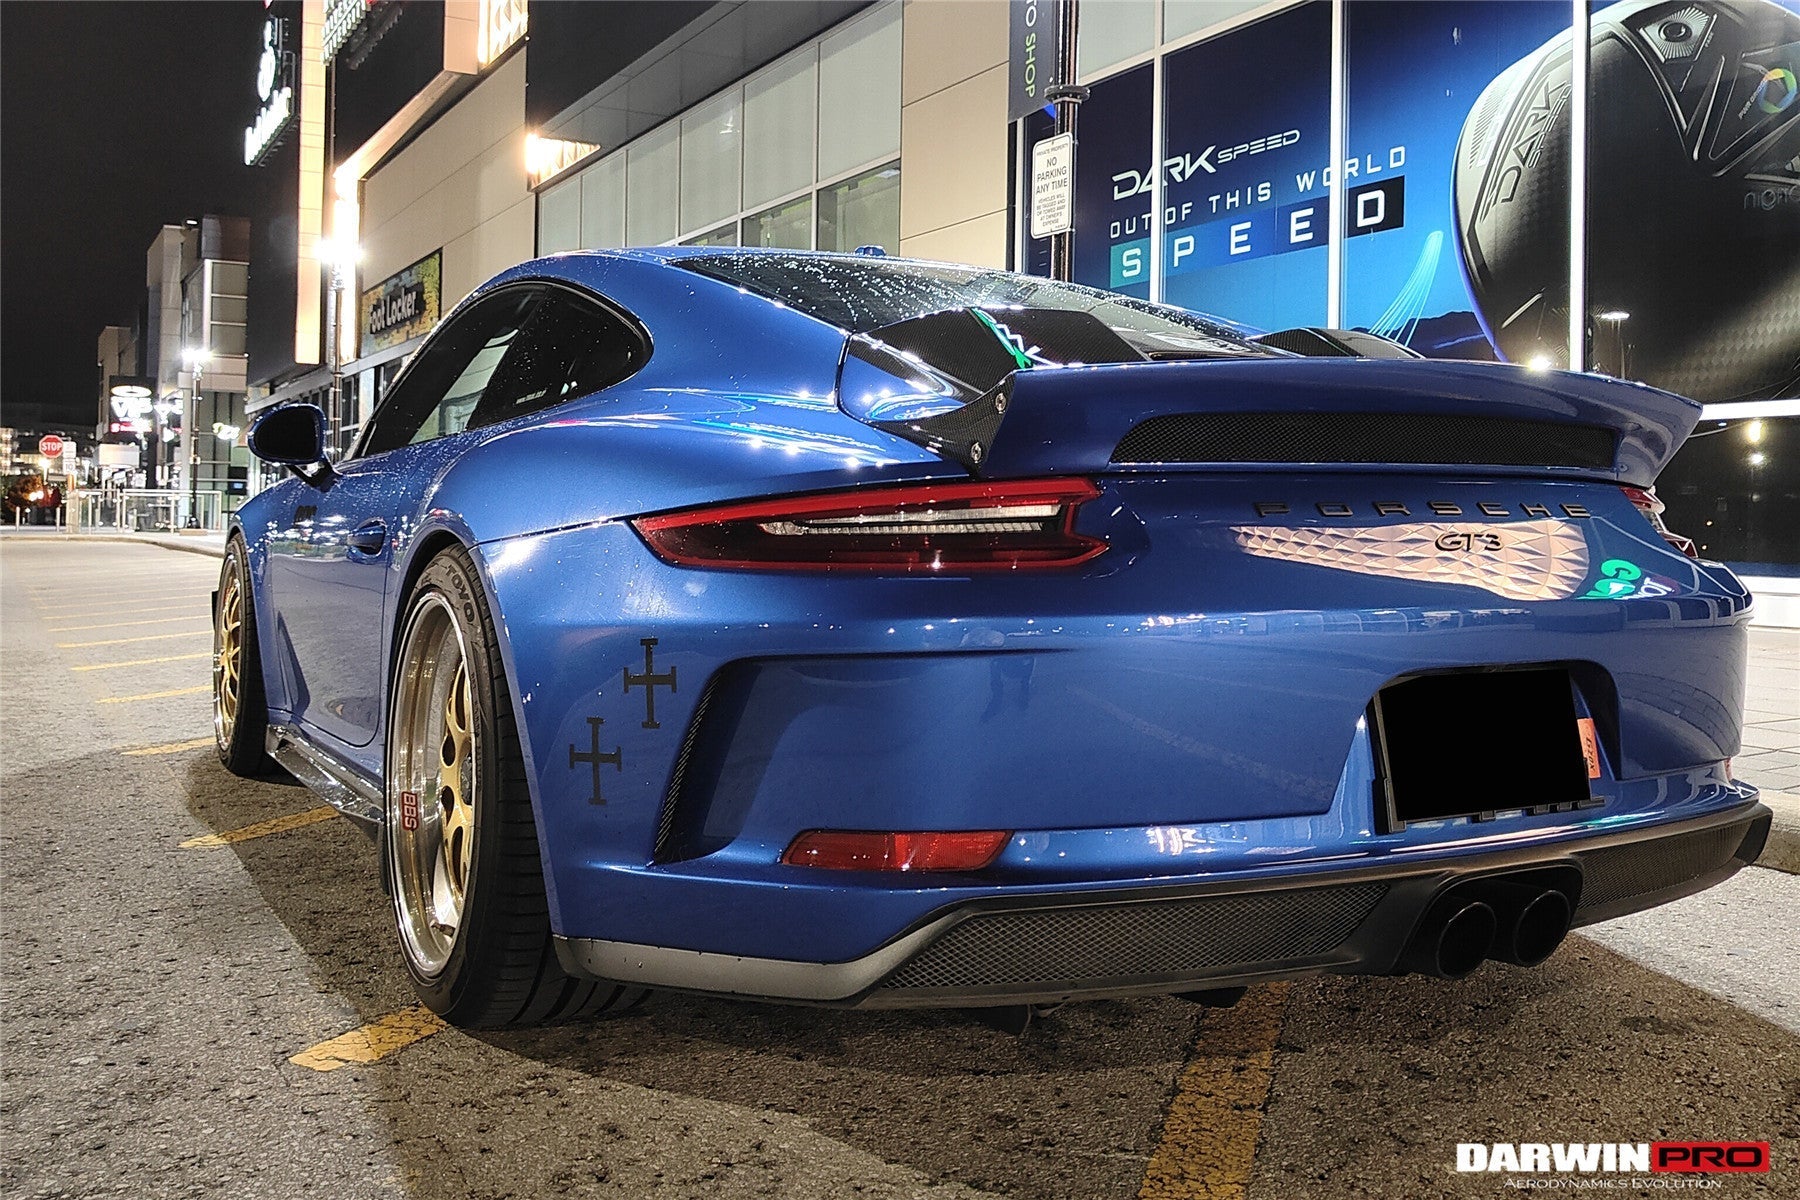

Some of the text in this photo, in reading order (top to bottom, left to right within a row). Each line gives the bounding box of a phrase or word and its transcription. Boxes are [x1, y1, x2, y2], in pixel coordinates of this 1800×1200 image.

[1025, 32, 1036, 97] SHOP
[1037, 165, 1067, 182] PARKING
[1046, 156, 1058, 168] NO
[1111, 129, 1301, 201] DARK SPEED
[1036, 177, 1068, 195] ANY TIME
[1110, 213, 1152, 239] OUT
[1165, 202, 1193, 225] OF
[1208, 181, 1271, 214] THIS
[1122, 189, 1386, 279] SPEED
[386, 286, 417, 327] Locker
[41, 441, 62, 451] STOP
[1254, 501, 1591, 518] PORSCHE
[1435, 532, 1504, 551] GT3
[446, 564, 475, 622] TOYO
[403, 792, 418, 829] BBS
